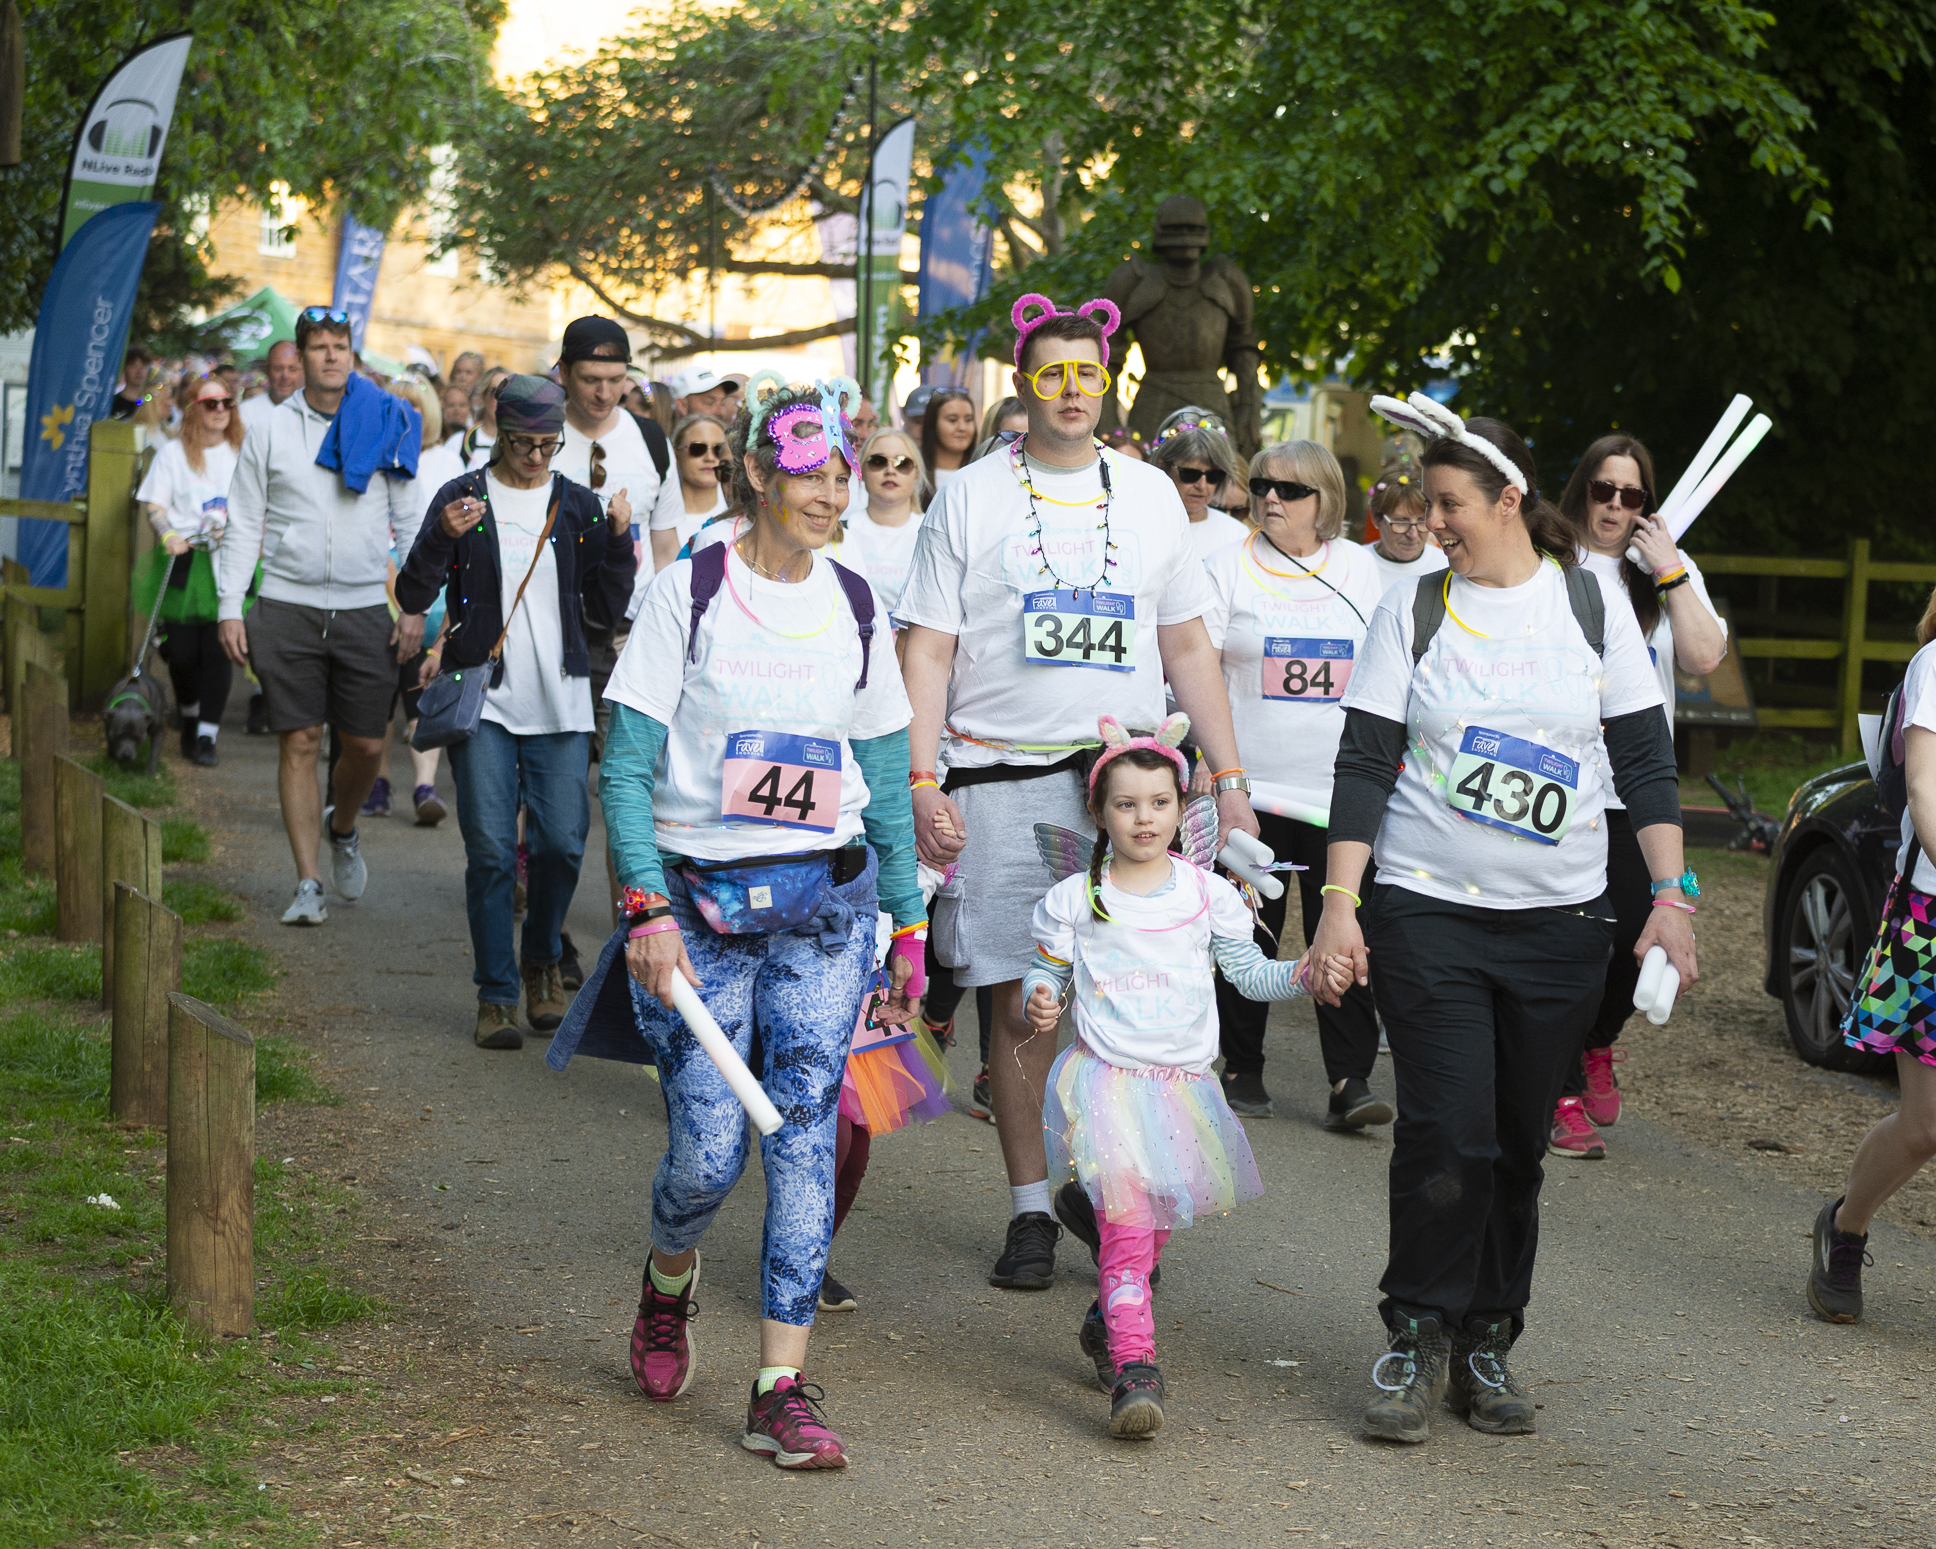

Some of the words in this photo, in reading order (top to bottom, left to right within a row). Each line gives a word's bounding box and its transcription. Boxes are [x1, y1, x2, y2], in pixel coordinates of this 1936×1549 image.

[73, 294, 114, 408] Spencer
[58, 413, 92, 500] ynthia
[1016, 558, 1100, 584] WALK
[1096, 604, 1115, 612] WALK
[1261, 601, 1329, 613] TWILIGHT
[1264, 614, 1333, 631] WALK
[1034, 614, 1127, 663] 344
[716, 659, 815, 680] TWILIGHT
[1283, 660, 1334, 696] 84
[1443, 658, 1538, 677] TWILIGHT
[717, 681, 816, 713] WALK
[1443, 680, 1541, 703] WALK
[736, 739, 765, 754] Favell
[1472, 736, 1501, 755] Favell
[806, 753, 825, 762] WALK
[1543, 762, 1563, 776] WALK
[748, 765, 816, 821] 44
[1456, 762, 1567, 834] 430
[1090, 994, 1177, 1022] WALK
